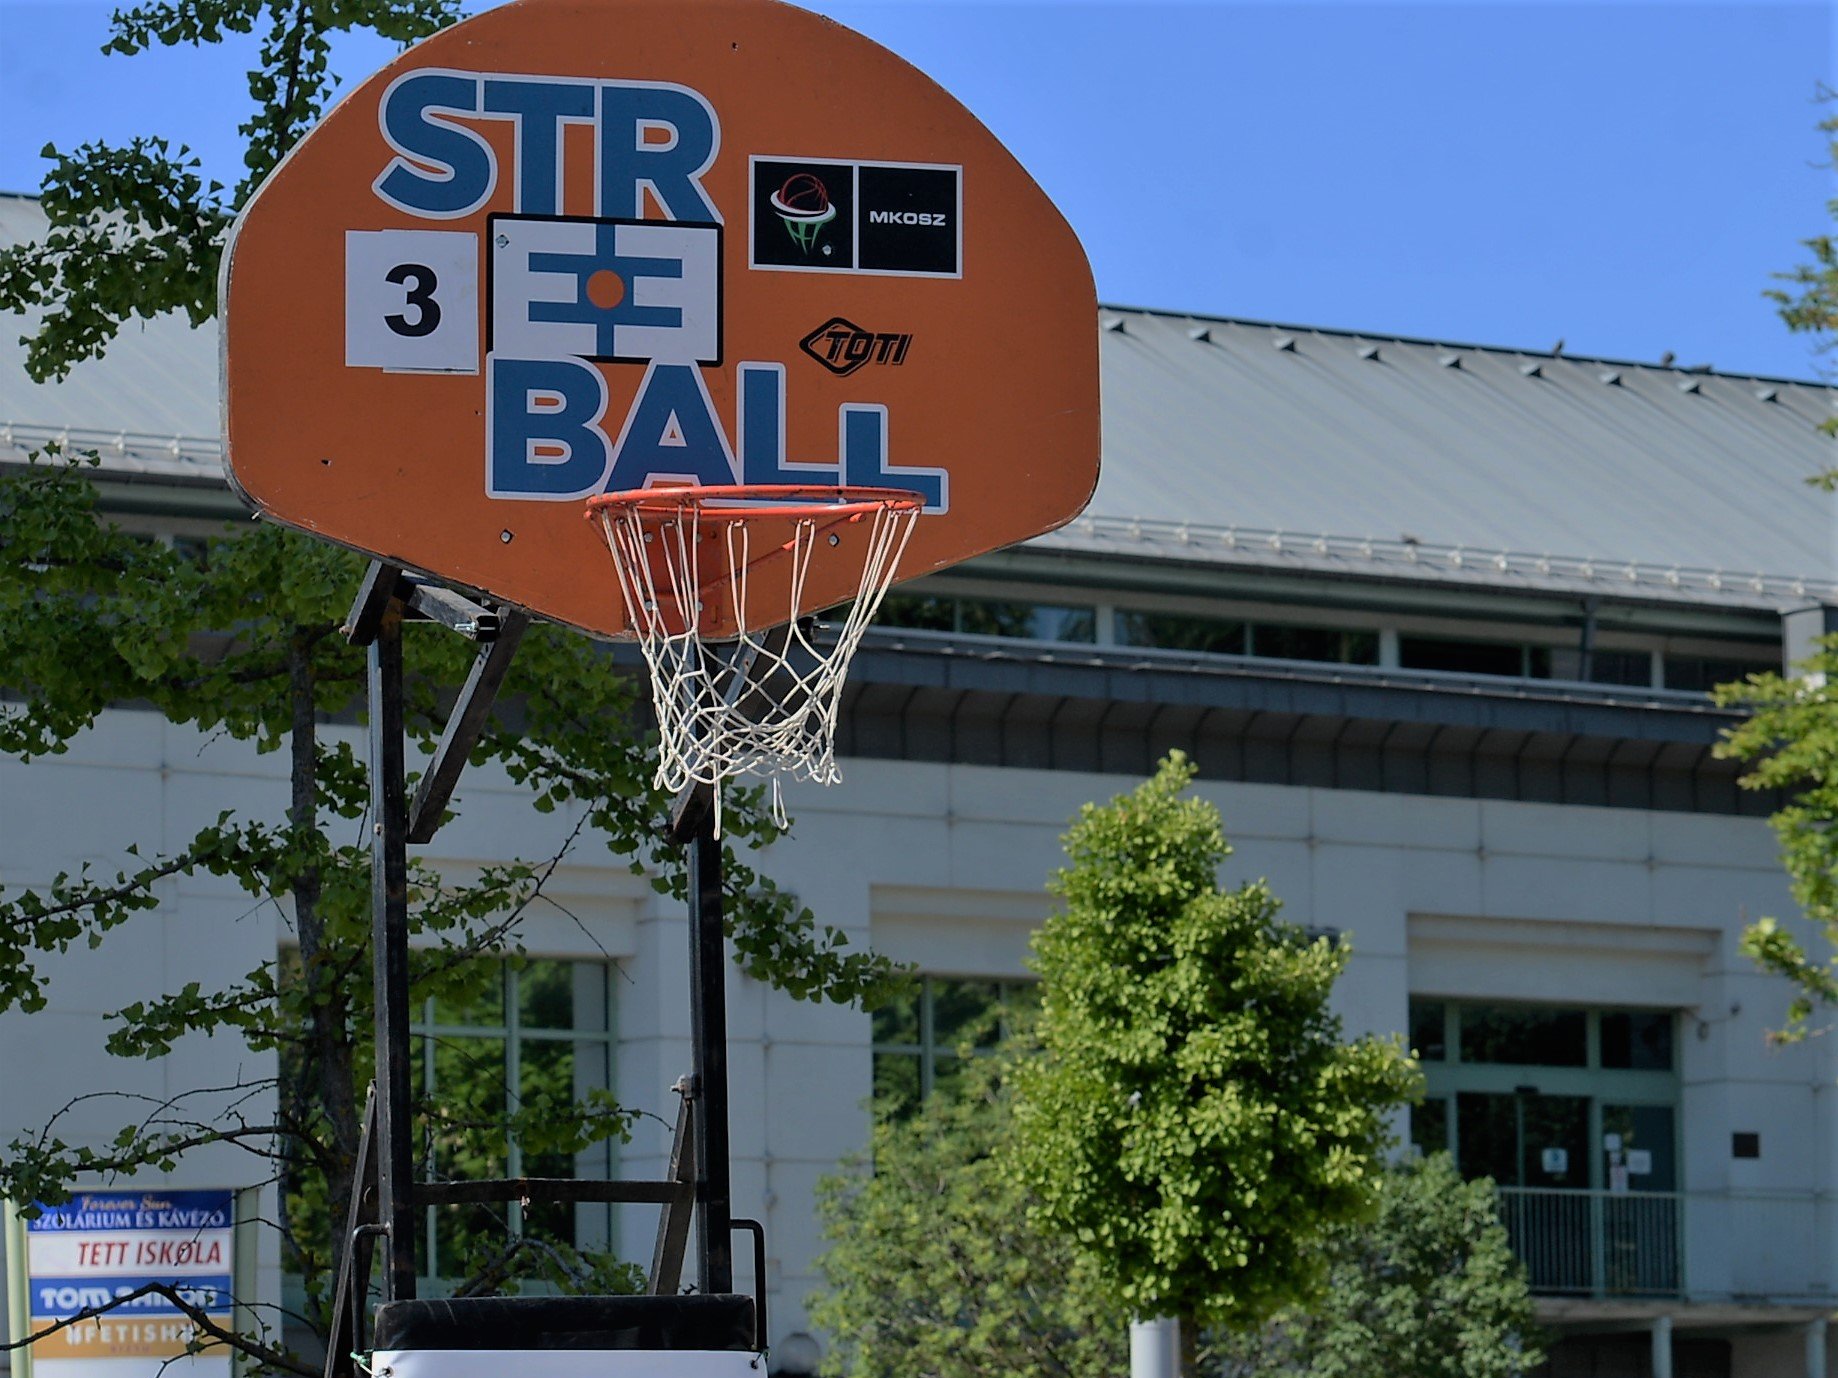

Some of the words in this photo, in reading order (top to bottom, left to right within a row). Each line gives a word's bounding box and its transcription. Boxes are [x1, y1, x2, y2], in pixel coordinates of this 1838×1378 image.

[373, 68, 723, 225] STR
[869, 210, 947, 227] MKOSZ
[384, 263, 442, 338] 3
[823, 330, 914, 367] TOTI
[485, 352, 949, 516] BALL
[135, 1210, 156, 1228] ÉS
[78, 1241, 130, 1266] TETT
[135, 1240, 222, 1265] ISKOLA
[39, 1286, 110, 1310] TOM
